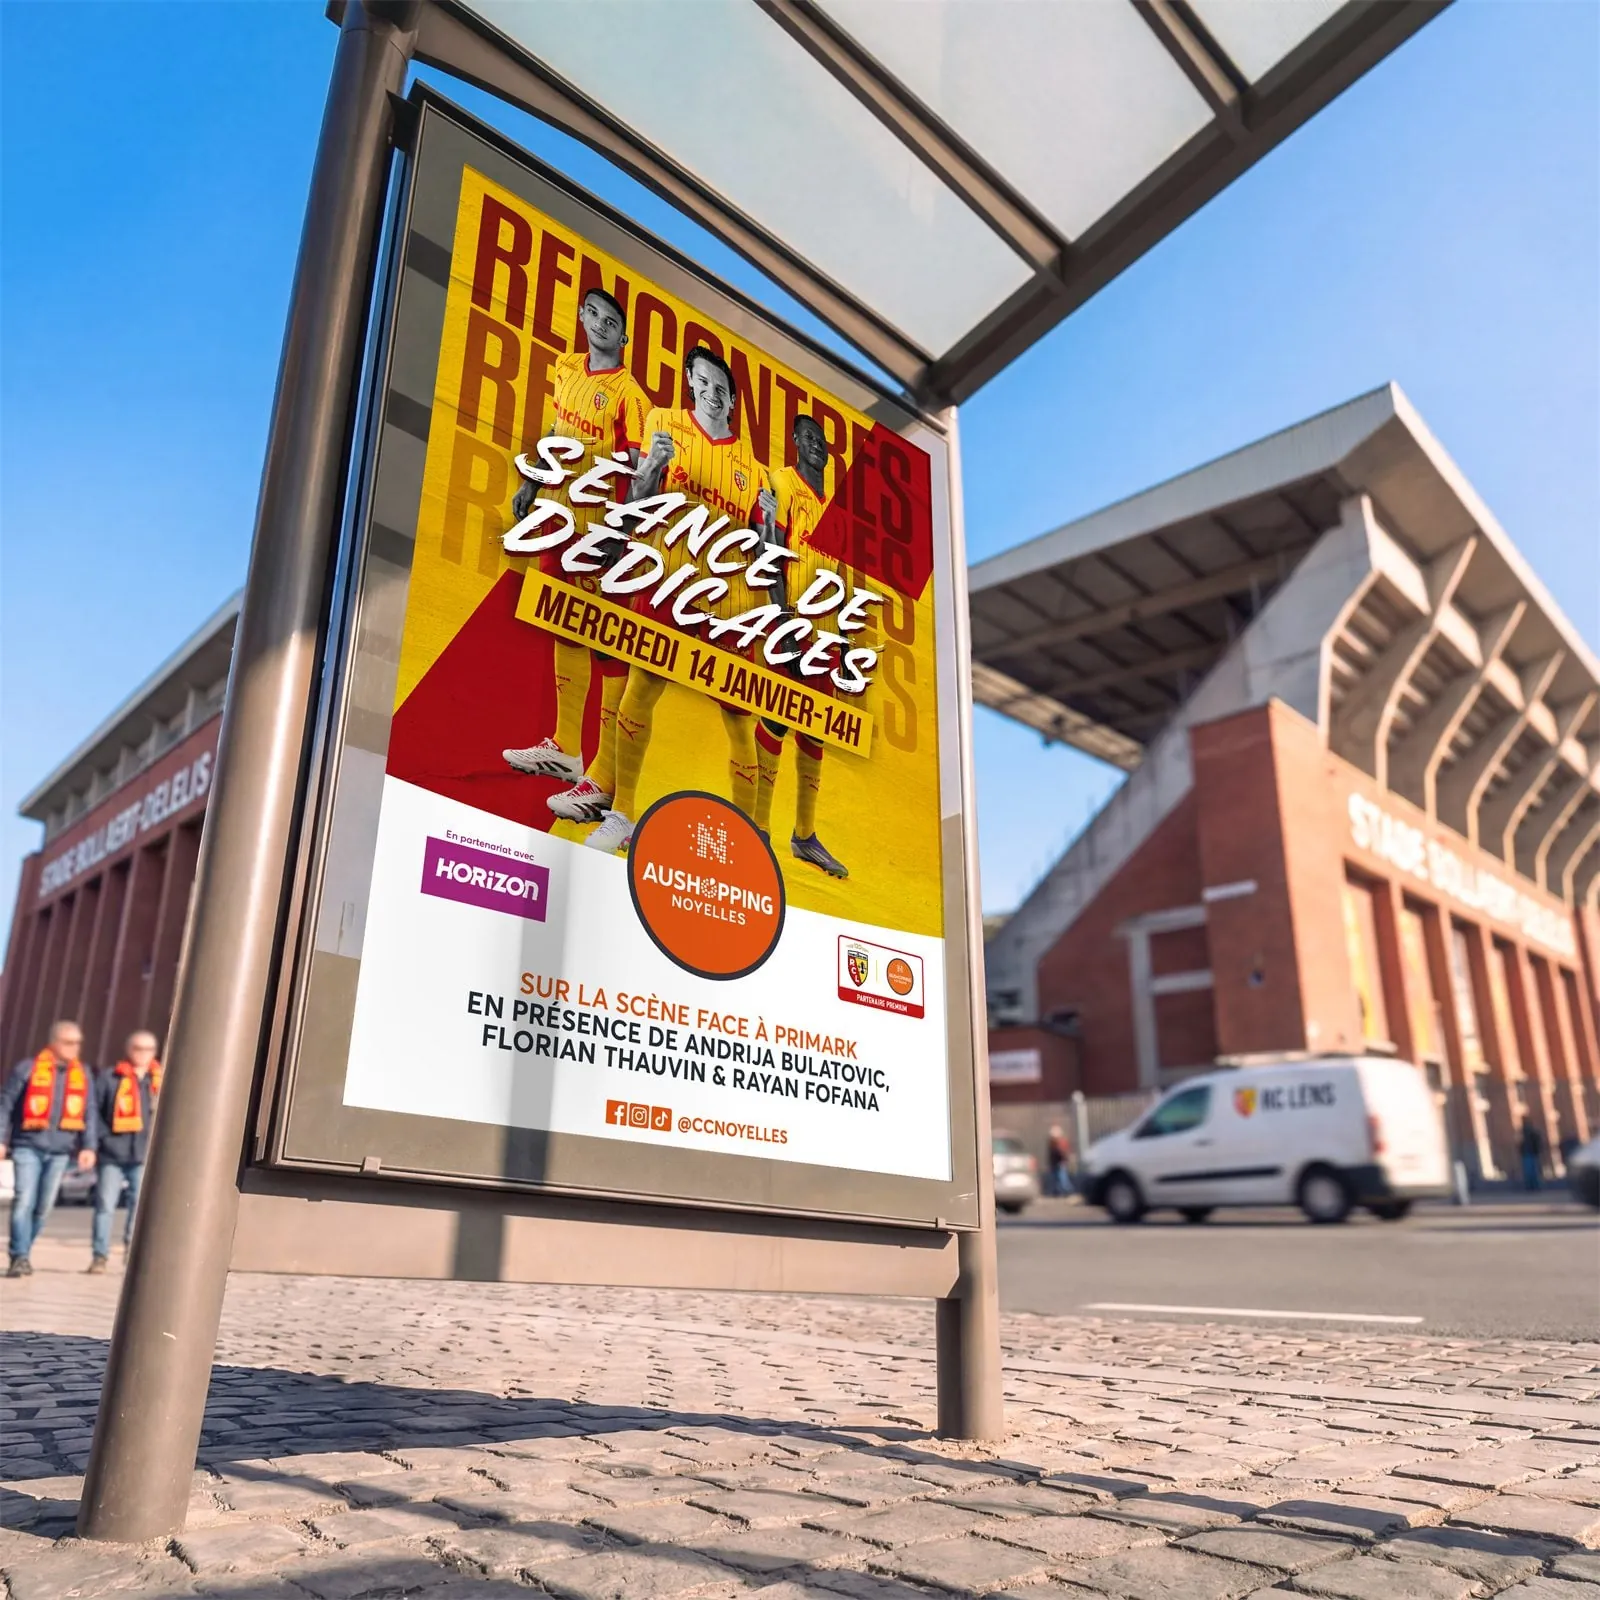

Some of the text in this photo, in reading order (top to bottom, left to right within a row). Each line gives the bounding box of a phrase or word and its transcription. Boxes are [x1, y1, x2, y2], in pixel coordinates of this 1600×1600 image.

[553, 400, 605, 441] uchan
[671, 465, 747, 523] Auchan
[514, 436, 802, 587] SÉANCE
[797, 568, 885, 631] DE
[534, 583, 680, 673] MERCREDI
[689, 649, 717, 688] 14
[719, 662, 863, 747] JANVIER-14H
[446, 829, 535, 862] En partenariat avec
[642, 861, 774, 915] AUSHOPPING
[671, 894, 747, 926] NOYELLES
[520, 972, 858, 1060] SUR LA SCÈNE FACE À PRIMARK
[856, 993, 908, 1013] PARTENAIRE PREMIUM
[467, 990, 890, 1093] EN PRÉSENCE DE ANDRIJA BULATOVIC,
[482, 1023, 880, 1112] FLORIAN THAUVIN & RAYAN FOFANA
[677, 1116, 788, 1145] @CCNOYELLES
